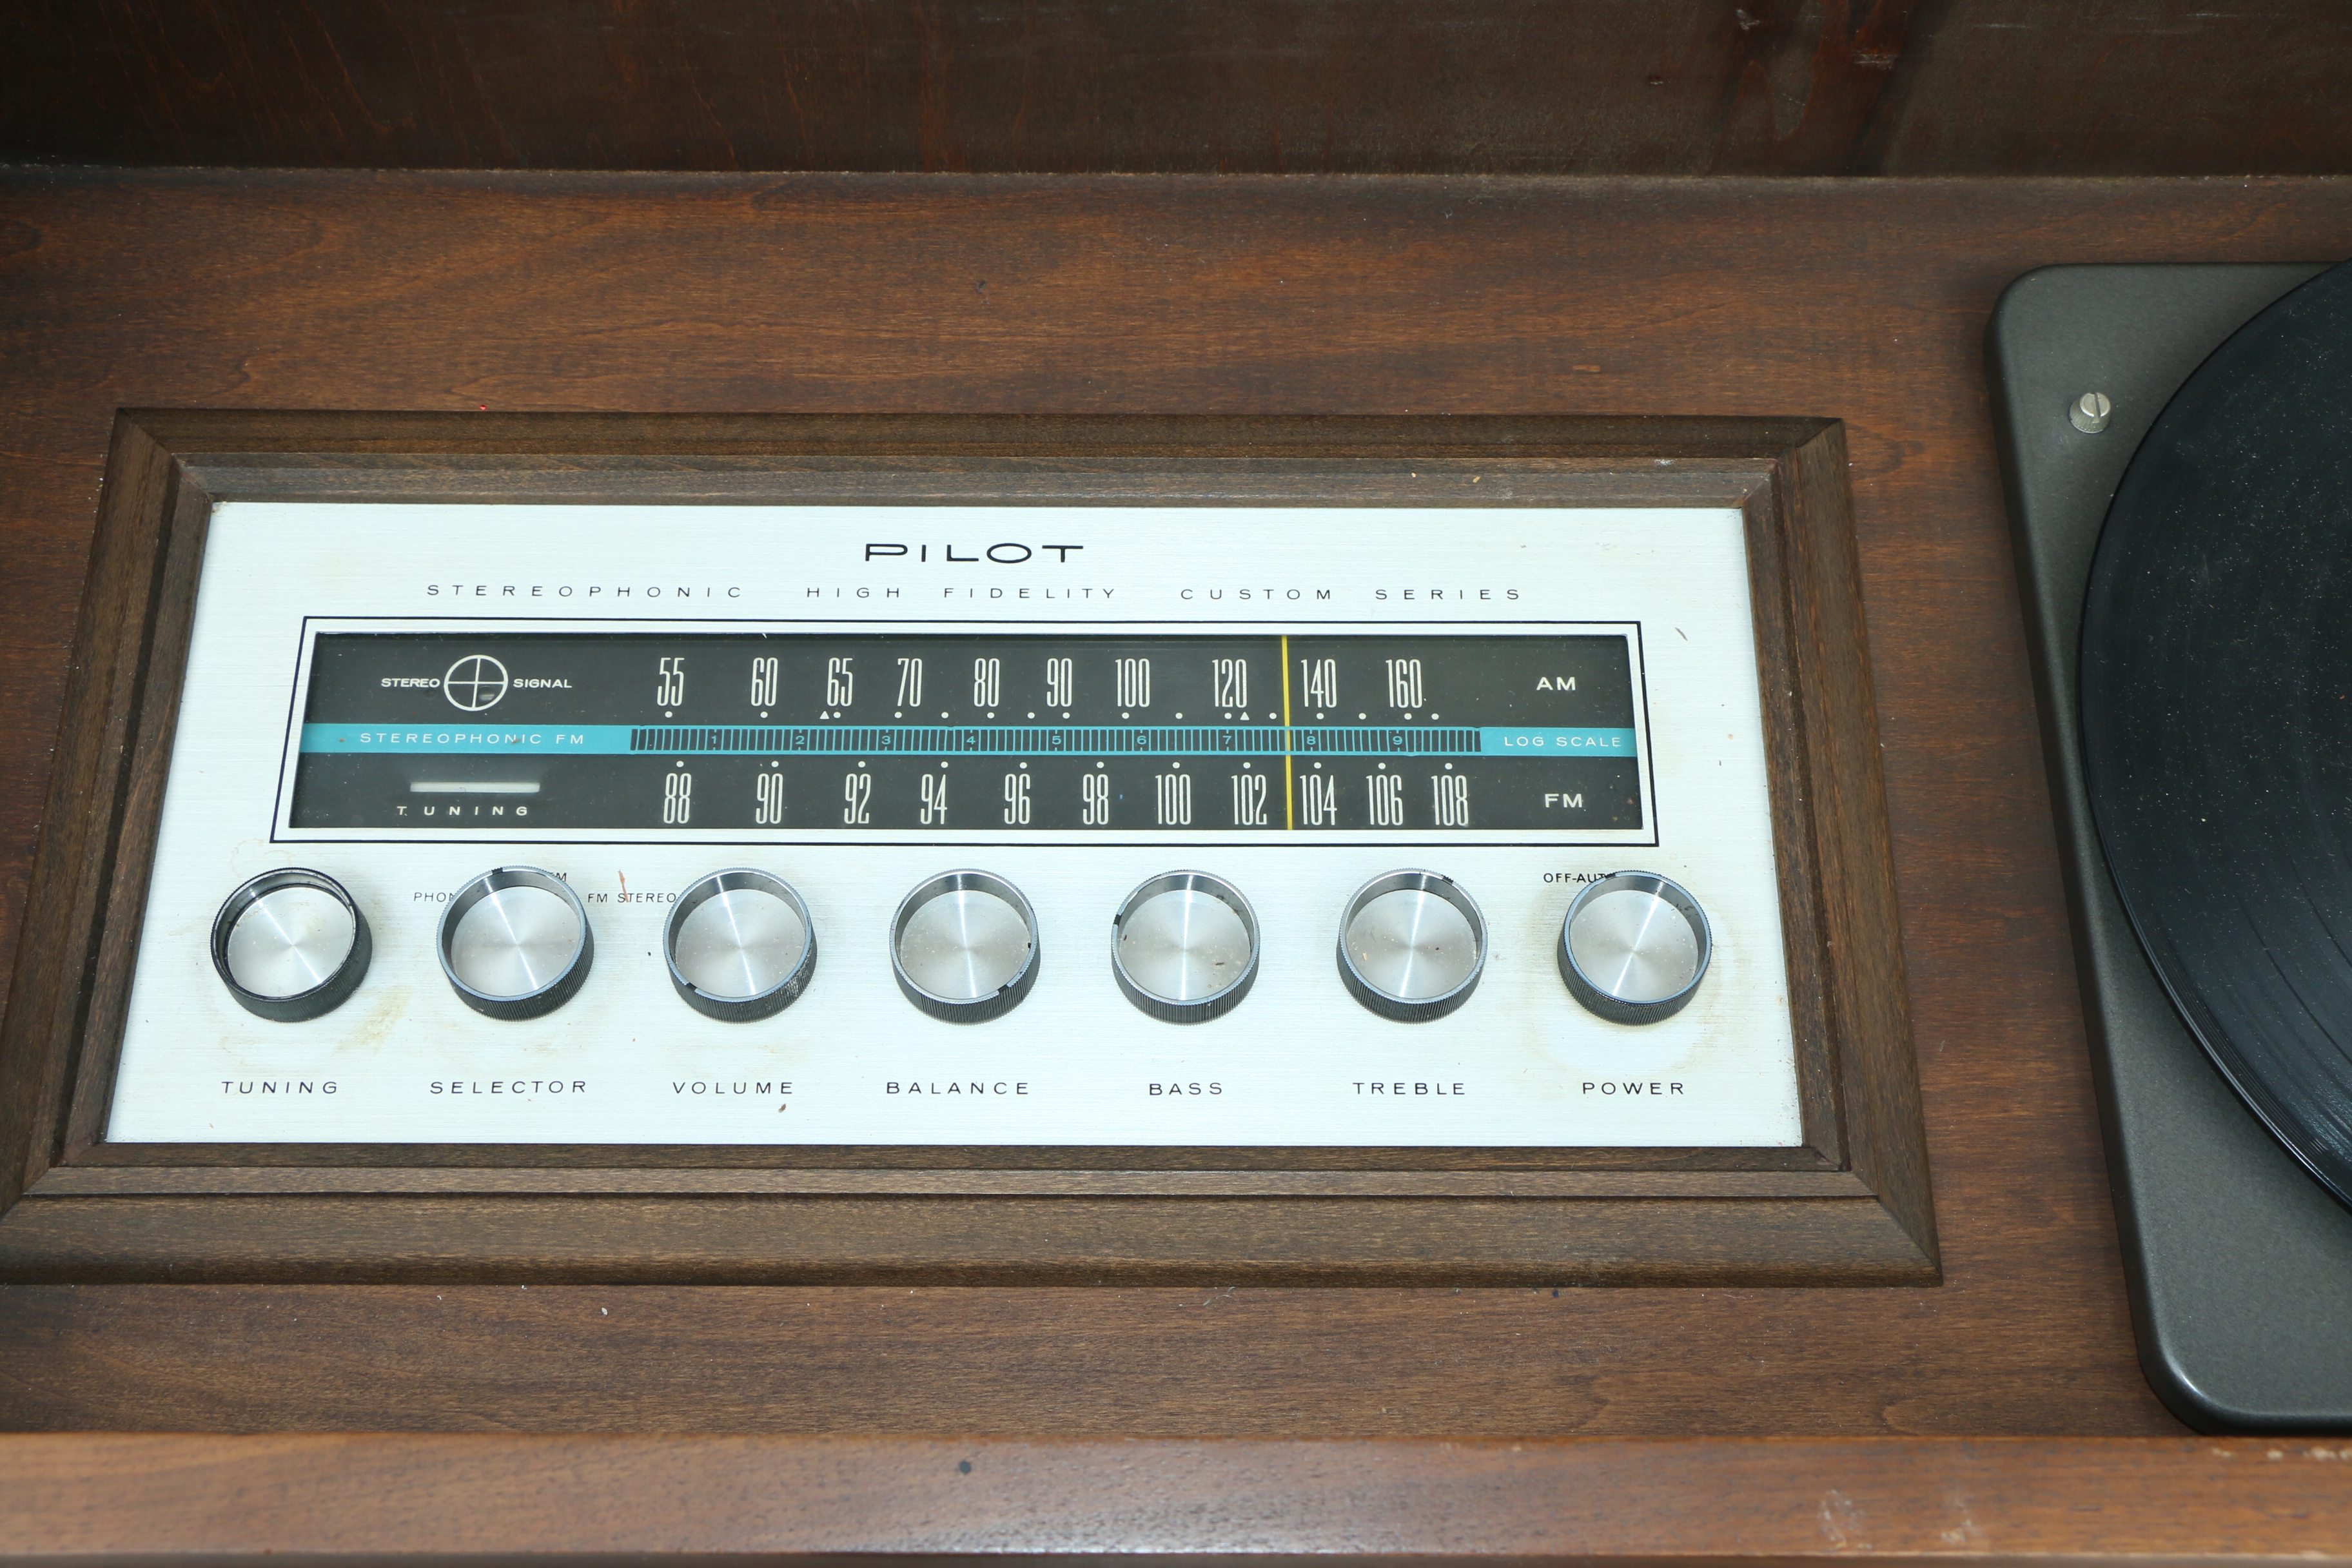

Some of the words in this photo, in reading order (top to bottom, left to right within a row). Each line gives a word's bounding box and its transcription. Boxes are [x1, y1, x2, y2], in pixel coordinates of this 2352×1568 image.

[865, 542, 1084, 564] PILOT
[427, 585, 742, 598] STEREOPHONIC
[807, 587, 899, 598] HIGH
[944, 587, 1114, 599] FIDELITY
[1181, 589, 1331, 600] CUSTOM
[1375, 589, 1520, 600] SERIES
[380, 678, 440, 689] STEREO
[513, 678, 573, 689] SIGNAL
[656, 657, 685, 707] 55
[750, 657, 778, 707] 60
[827, 657, 853, 707] 65
[897, 658, 923, 707] 70
[974, 658, 1000, 707] 80
[1046, 658, 1073, 707] 90
[1115, 658, 1151, 708] 100
[1211, 658, 1248, 709] 120
[1300, 658, 1337, 709] 140
[1385, 658, 1423, 709] 160
[1535, 676, 1576, 692] AM
[359, 732, 542, 744] STEREOPHONIC
[556, 734, 585, 745] FM
[710, 736, 717, 744] 1
[795, 736, 805, 745] 2
[881, 736, 892, 745] 3
[966, 736, 976, 745] 4
[1051, 736, 1062, 745] 5
[1136, 736, 1147, 745] 6
[1222, 736, 1232, 745] 7
[1306, 736, 1317, 745] 8
[1392, 736, 1403, 745] 9
[1504, 736, 1545, 747] LOG
[1556, 736, 1622, 748] SCALE
[663, 772, 692, 824] 88
[755, 773, 783, 825] 90
[843, 773, 872, 825] 92
[920, 773, 948, 825] 94
[1004, 773, 1031, 825] 96
[1083, 774, 1109, 825] 98
[1155, 774, 1192, 826] 100
[1231, 774, 1268, 826] 102
[1299, 774, 1338, 826] 104
[1366, 774, 1404, 826] 106
[1431, 774, 1469, 827] 108
[1544, 793, 1584, 808] FM
[397, 805, 529, 817] TUNING
[587, 892, 608, 903] FM
[617, 892, 677, 903] STEREO
[221, 1080, 338, 1095] TUNING
[429, 1080, 587, 1095] SELECTOR
[672, 1081, 794, 1095] VOLUME
[886, 1081, 1029, 1095] BALANCE
[1149, 1082, 1223, 1096] BASS
[1351, 1082, 1466, 1095] TREBLE
[1582, 1082, 1685, 1095] POWER
